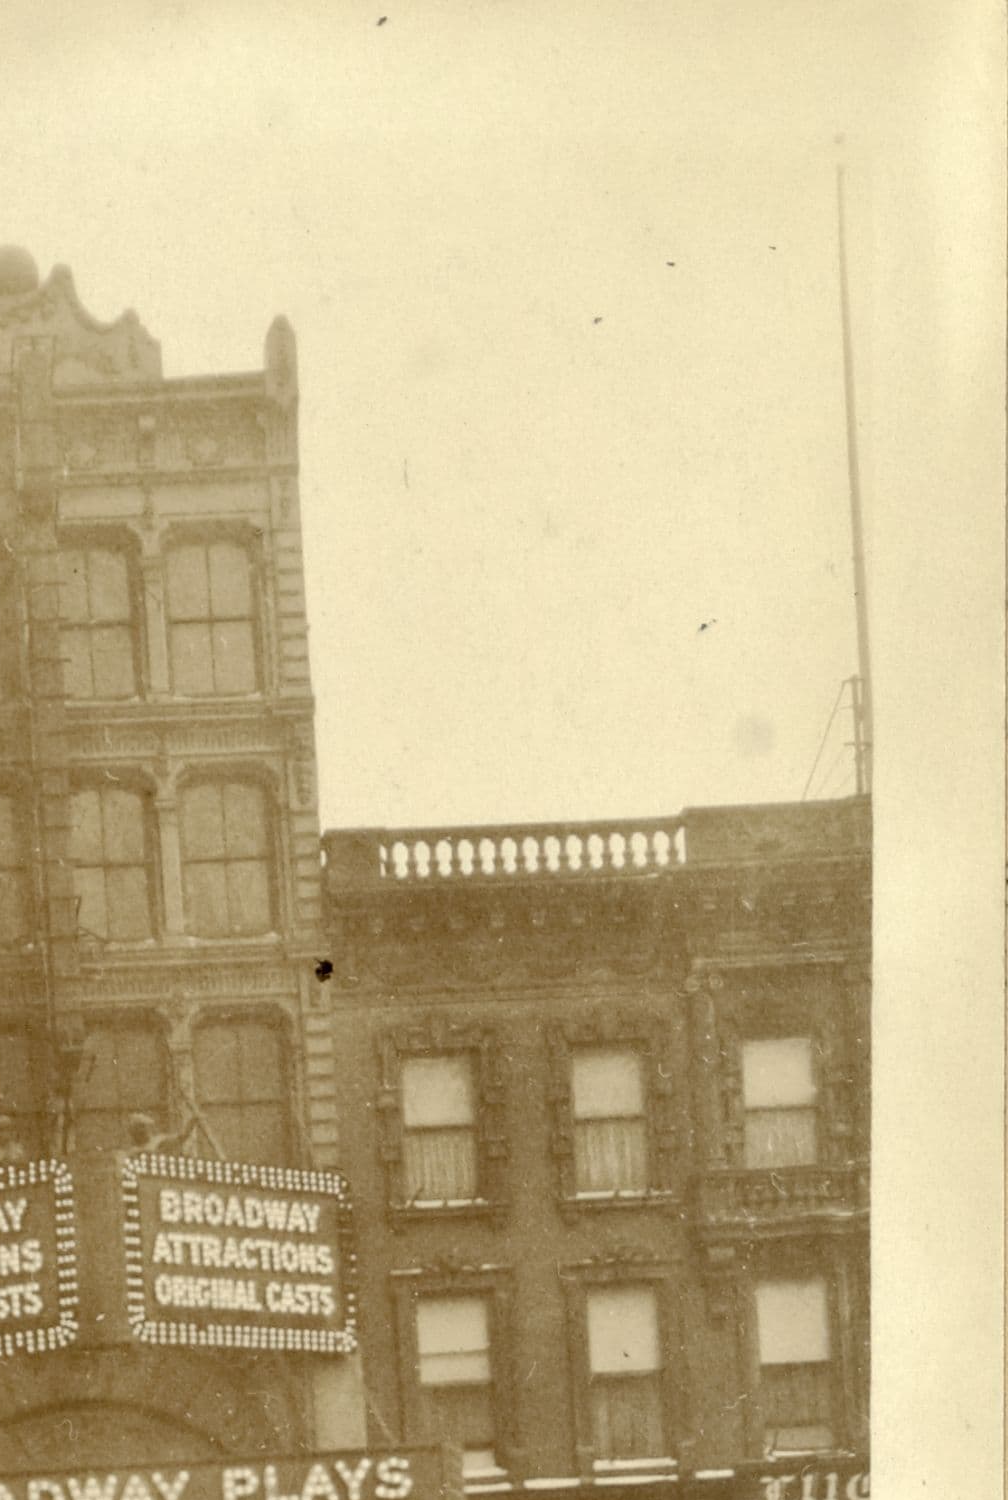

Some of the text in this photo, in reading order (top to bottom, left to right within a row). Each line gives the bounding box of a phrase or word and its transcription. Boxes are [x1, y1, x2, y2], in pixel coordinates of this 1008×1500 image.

[160, 1189, 320, 1234] BROADWAY
[152, 1232, 334, 1275] ATTRACTIONS
[155, 1273, 336, 1316] ORIGINAL CASTS
